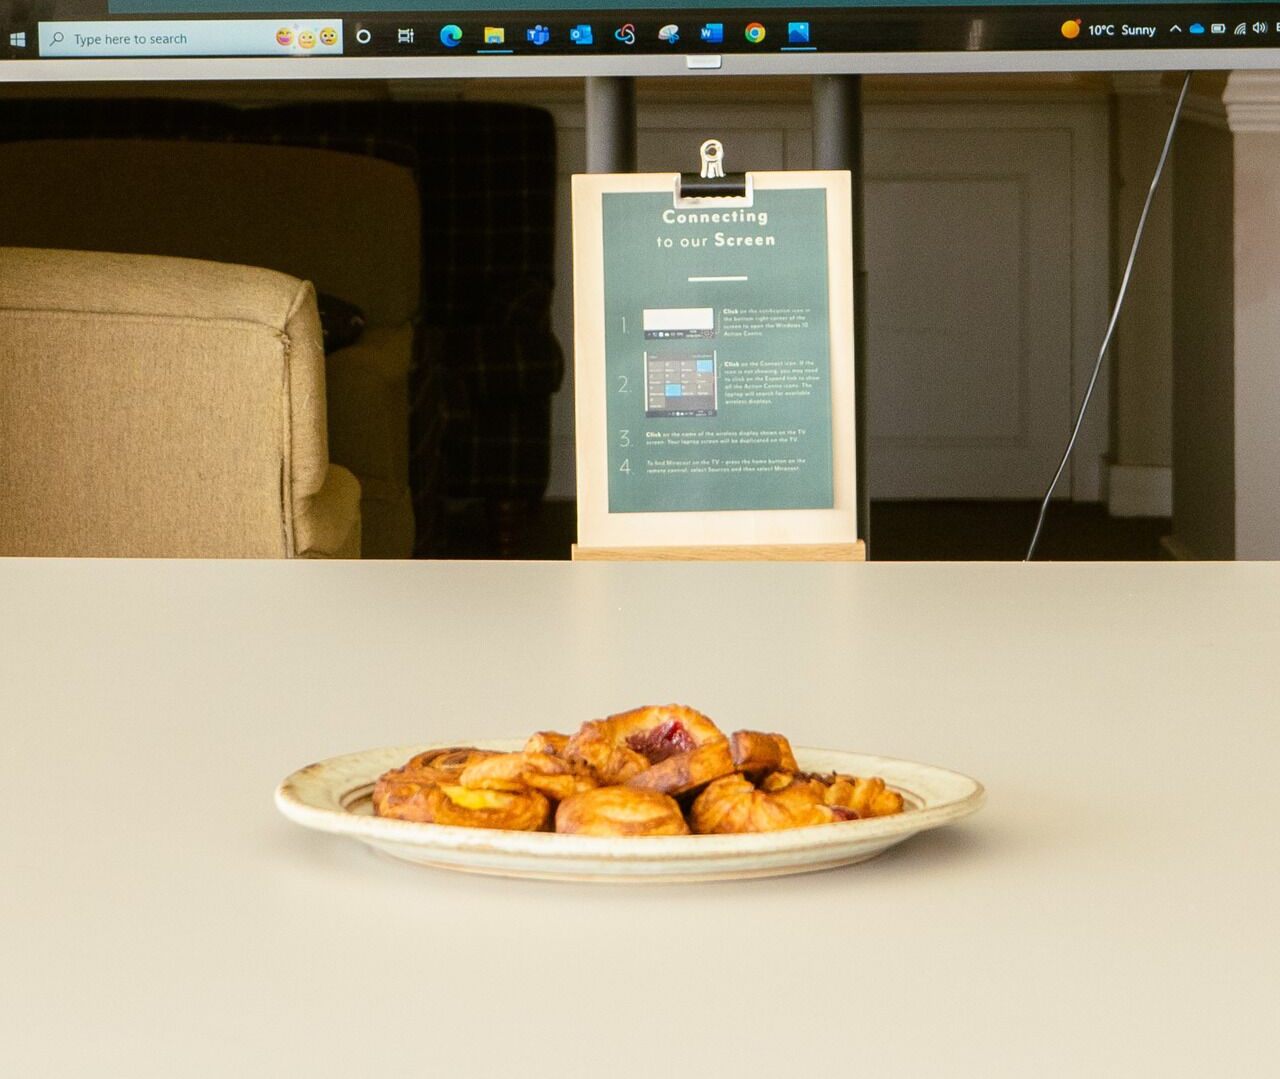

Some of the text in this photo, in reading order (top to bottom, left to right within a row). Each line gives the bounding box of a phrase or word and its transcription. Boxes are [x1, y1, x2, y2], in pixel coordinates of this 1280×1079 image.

[1088, 24, 1156, 38] 10°C Sunny
[74, 33, 187, 47] Type here to search
[662, 209, 768, 226] Connecting
[656, 232, 775, 248] to our Screen
